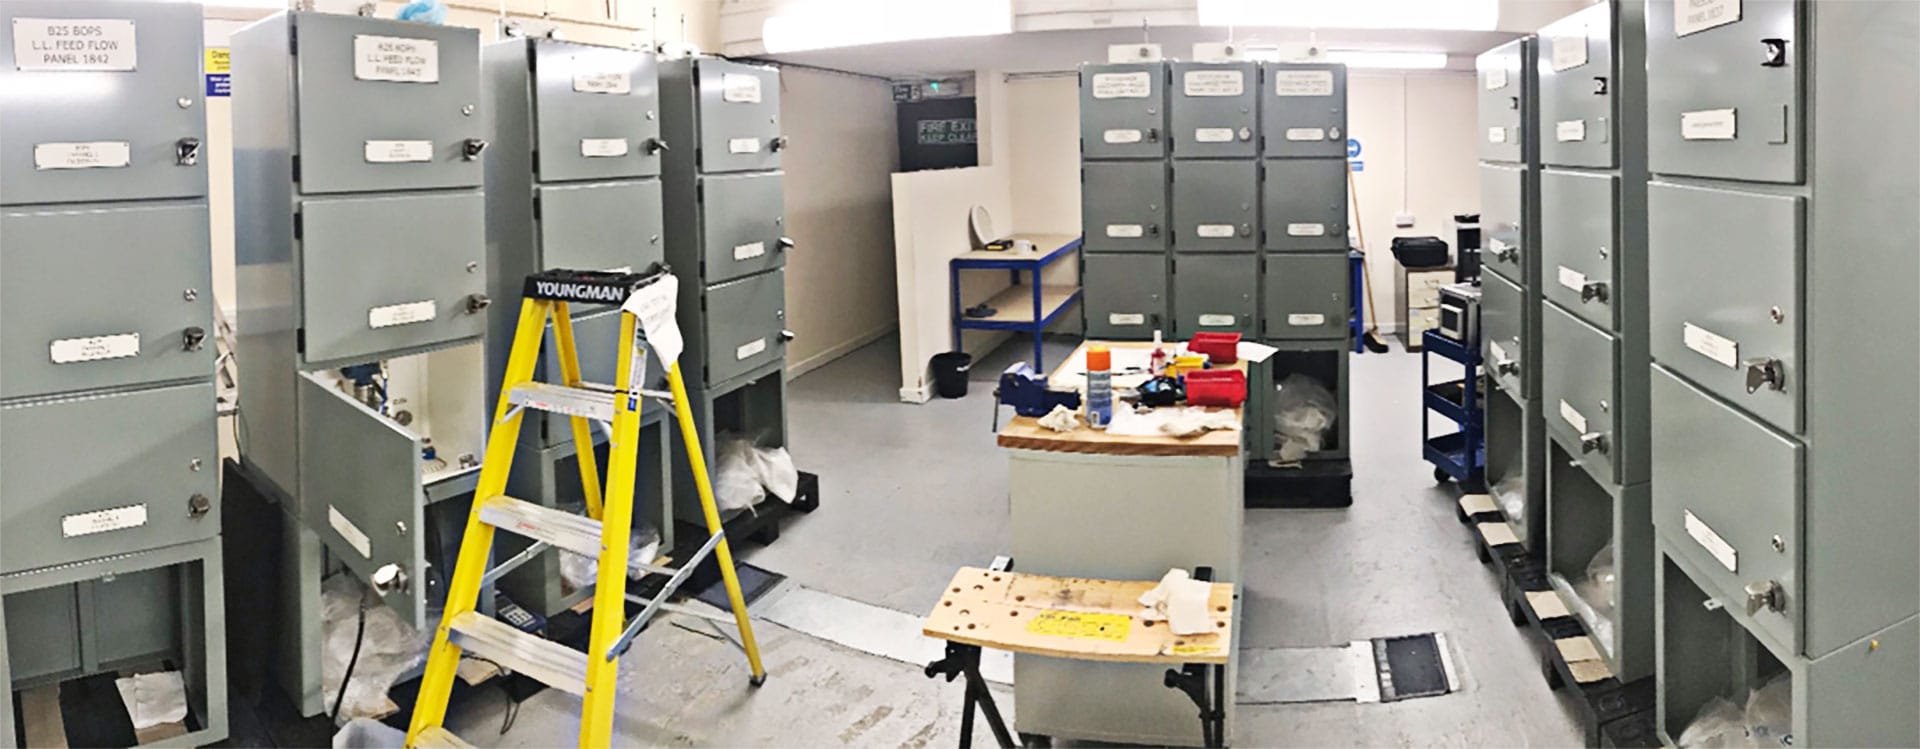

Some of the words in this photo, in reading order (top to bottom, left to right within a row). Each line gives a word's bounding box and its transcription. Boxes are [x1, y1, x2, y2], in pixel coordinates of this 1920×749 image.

[47, 26, 69, 36] B25
[73, 26, 102, 36] BOPS
[56, 40, 85, 50] FEED
[88, 40, 119, 50] FLOW
[43, 54, 80, 64] PANEL
[83, 54, 109, 64] 1842
[919, 121, 946, 132] FIRE
[920, 133, 946, 143] KEEP
[536, 281, 624, 301] YOUNGMAN
